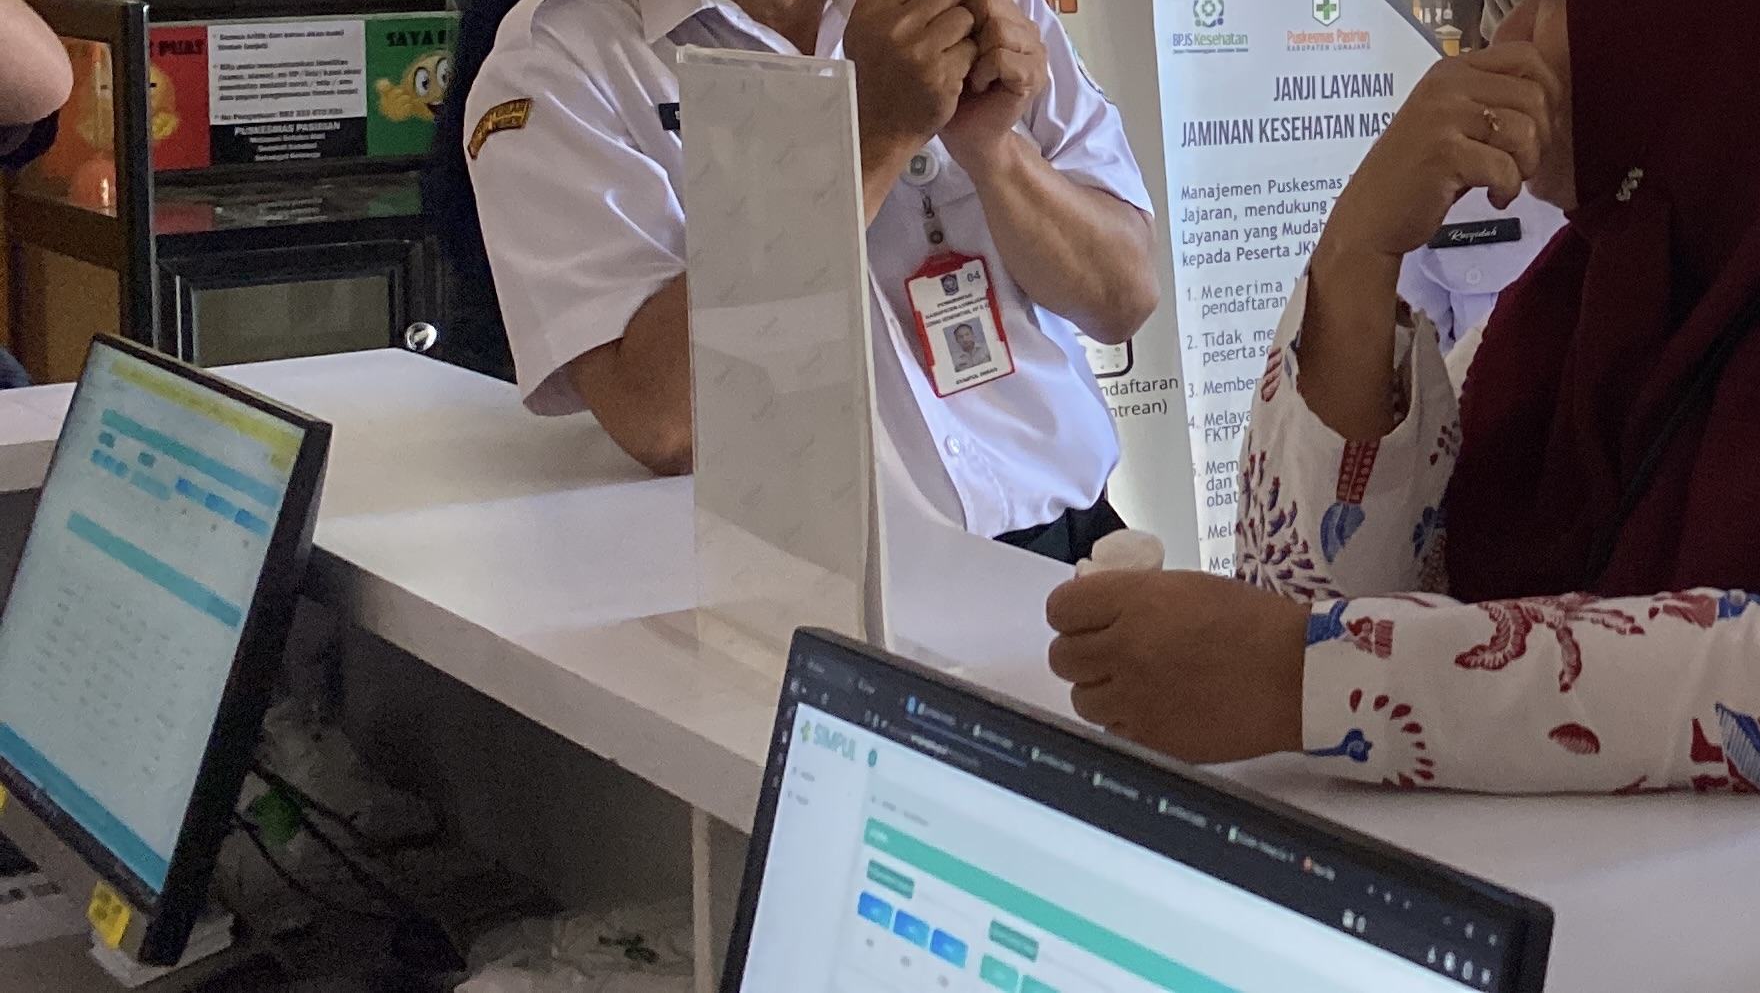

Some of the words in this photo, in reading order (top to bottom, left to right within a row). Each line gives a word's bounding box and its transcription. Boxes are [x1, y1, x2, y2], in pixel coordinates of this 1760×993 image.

[385, 29, 435, 47] SAYA
[1173, 32, 1193, 47] BPJS
[1193, 32, 1249, 46] Kesehatan
[1287, 29, 1334, 44] Puskesmas
[1273, 75, 1317, 102] JANJI
[1321, 72, 1395, 99] LAYANAN
[1181, 118, 1253, 148] JAMINAN
[1259, 113, 1355, 143] KESEHATAN
[1359, 112, 1397, 137] NAS
[1181, 182, 1262, 202] Manajemen
[1268, 177, 1343, 194] Puskesmas
[1181, 206, 1238, 225] Jajaran,
[1244, 200, 1328, 217] mendukung
[1182, 226, 1239, 247] Layanan
[1244, 224, 1278, 242] yang
[1182, 248, 1232, 269] kepada
[1236, 245, 1290, 262] Peserta
[1294, 241, 1317, 257] JK
[1186, 288, 1196, 302] 1.
[1201, 278, 1283, 300] Menerima
[1202, 295, 1288, 319] pendaftaran
[1187, 335, 1198, 350] 2.
[1202, 329, 1243, 349] Tidak
[1253, 330, 1275, 342] me
[1202, 345, 1256, 367] peserta
[1100, 376, 1179, 397] ndaftaran
[1188, 383, 1199, 398] 3.
[1203, 377, 1260, 396] Member
[1111, 399, 1168, 418] ntrean)
[1204, 409, 1251, 427] Melaya
[1205, 425, 1241, 443] FKTP
[1205, 459, 1240, 475] Mem
[1206, 476, 1232, 492] dan
[1207, 490, 1238, 507] obat
[1207, 522, 1233, 540] Mel
[1209, 555, 1236, 572] Mel
